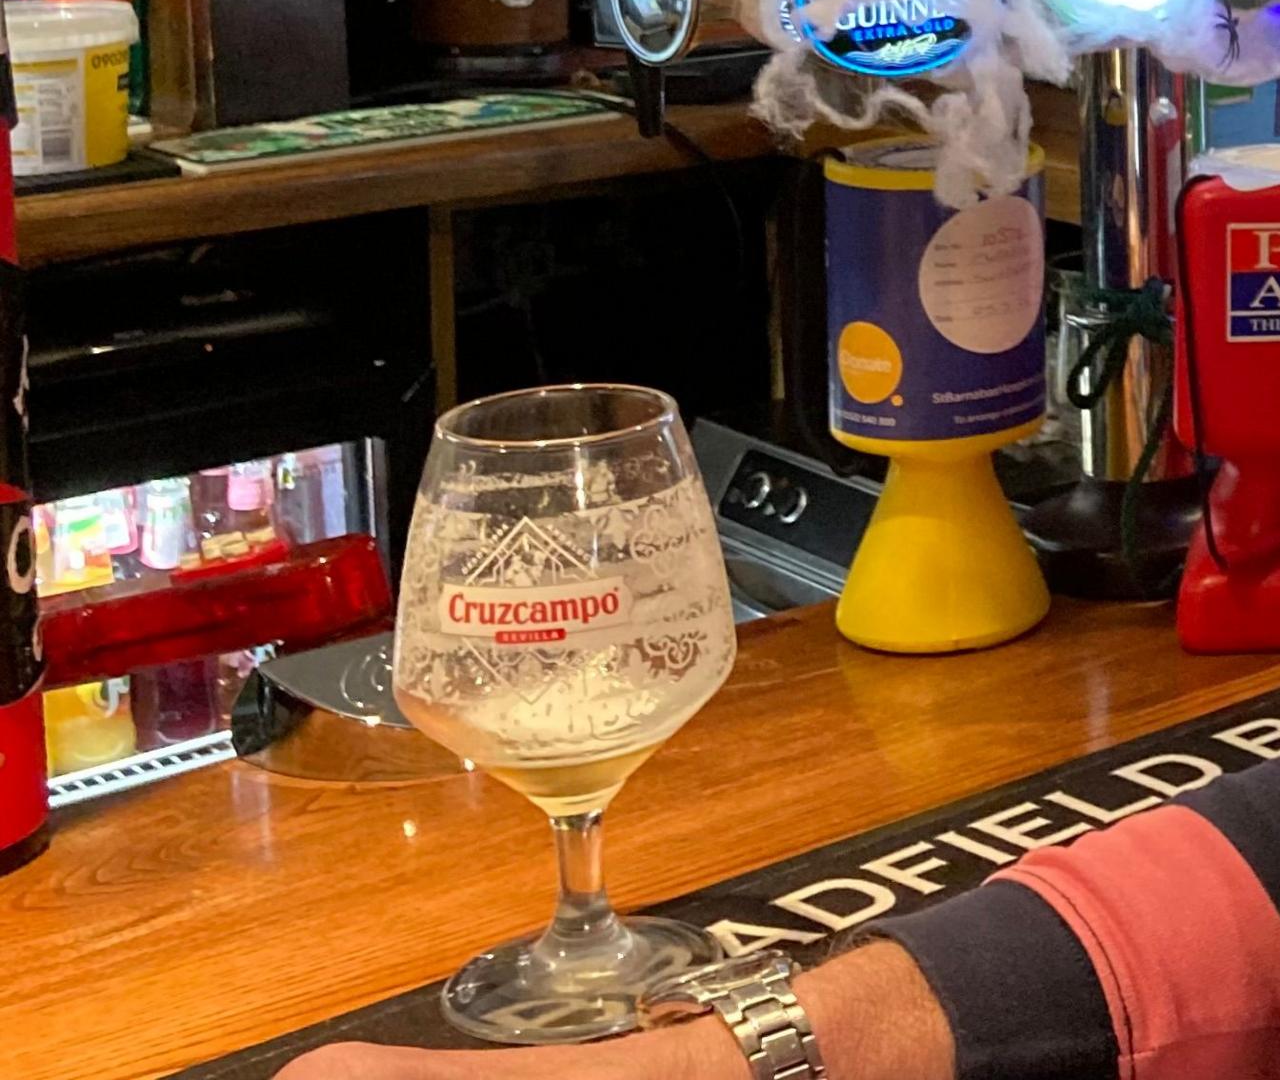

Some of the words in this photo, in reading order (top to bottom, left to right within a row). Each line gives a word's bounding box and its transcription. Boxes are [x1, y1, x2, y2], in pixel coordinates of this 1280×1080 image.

[852, 23, 906, 42] EXTRA
[911, 18, 957, 36] COLD
[448, 590, 620, 626] Cruzcampo
[500, 629, 561, 642] SEVILLA
